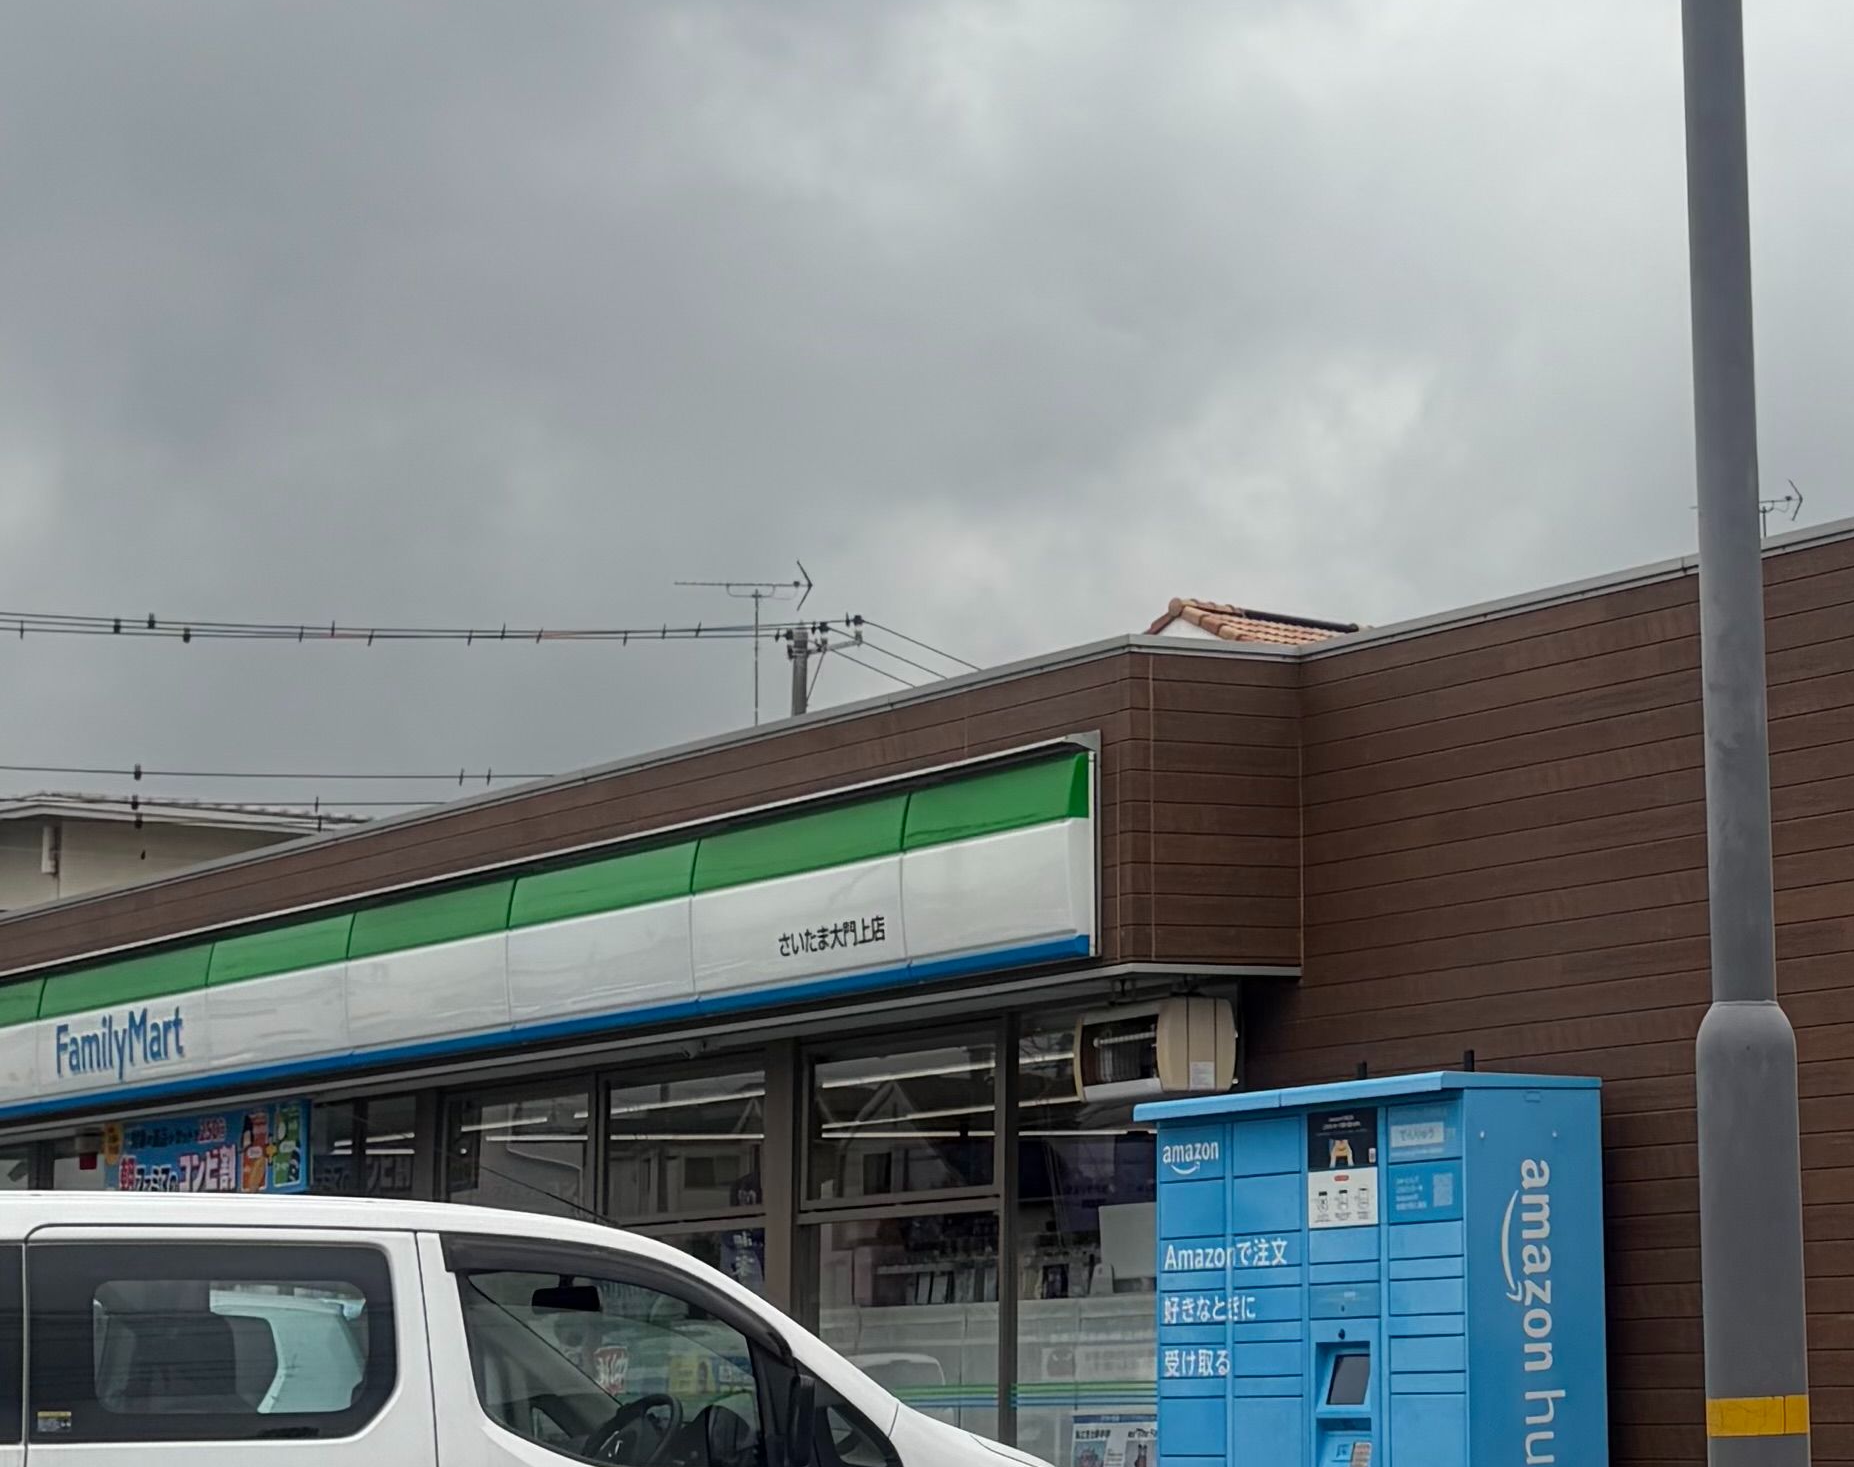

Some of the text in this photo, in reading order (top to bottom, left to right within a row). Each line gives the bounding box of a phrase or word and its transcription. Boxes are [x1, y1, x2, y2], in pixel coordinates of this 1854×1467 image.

[778, 916, 885, 957] さいたま大門上店
[56, 1006, 185, 1082] FamilyMart
[1162, 1140, 1219, 1164] amazon
[1163, 1237, 1289, 1271] Amazonで注文
[1519, 1158, 1554, 1372] amazon
[1163, 1296, 1257, 1324] 好きなときに
[1163, 1348, 1232, 1377] 受け取る
